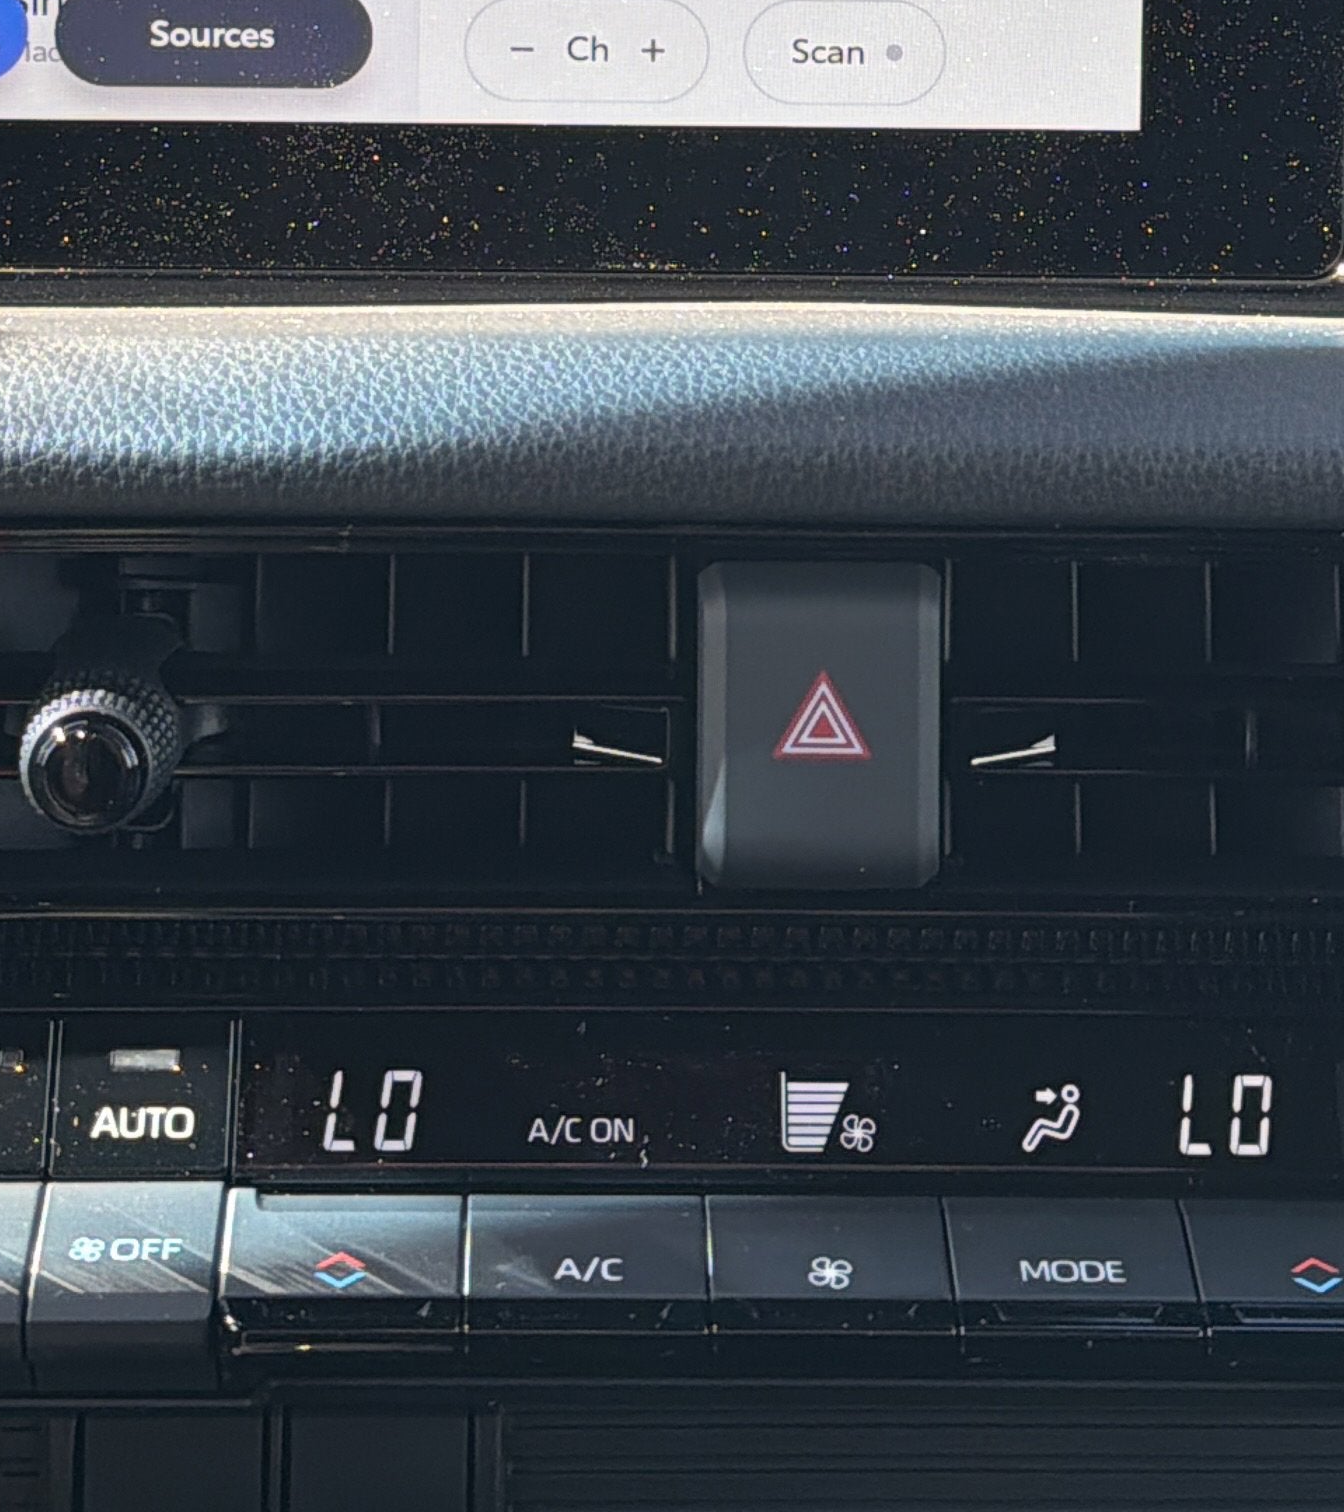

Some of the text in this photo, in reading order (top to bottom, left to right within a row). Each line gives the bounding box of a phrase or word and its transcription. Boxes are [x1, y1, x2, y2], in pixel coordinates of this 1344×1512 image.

[150, 19, 275, 50] Sources
[567, 35, 609, 63] Ch
[792, 38, 865, 66] Scan
[90, 1106, 195, 1140] AUTO
[528, 1116, 635, 1145] A/C ON
[109, 1237, 183, 1263] OFF
[554, 1257, 623, 1282] A/C
[1019, 1259, 1126, 1284] MODE
